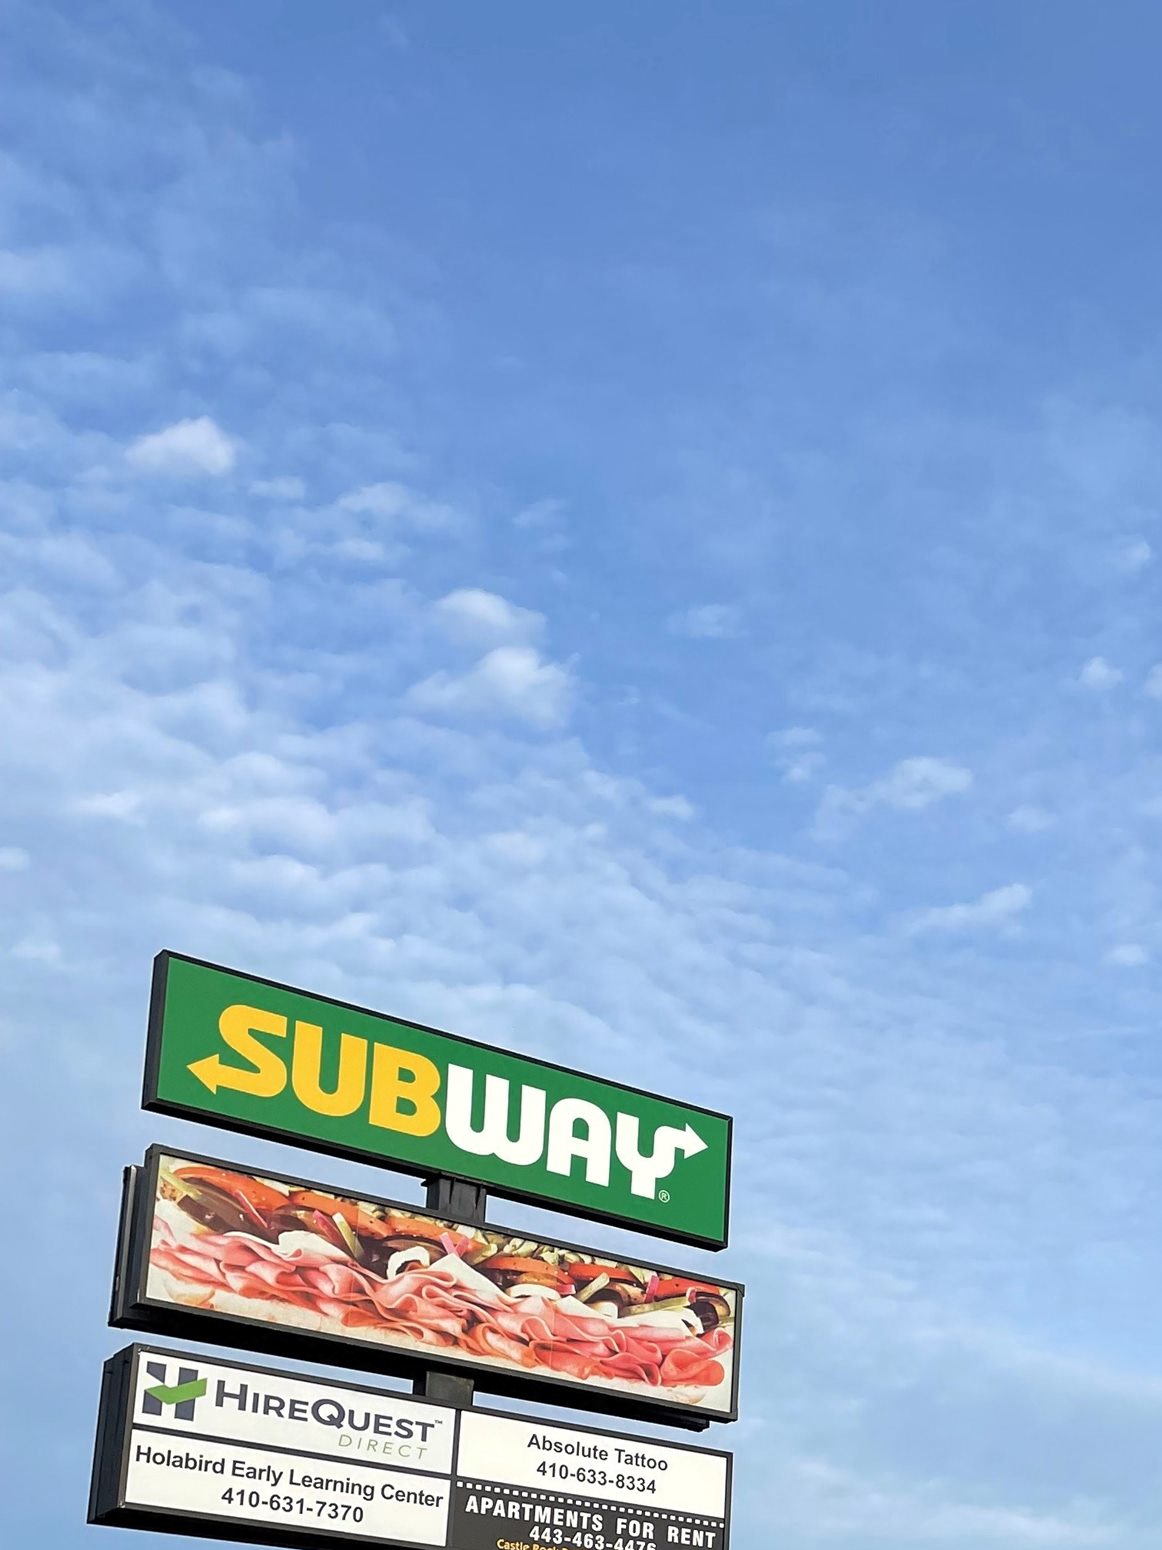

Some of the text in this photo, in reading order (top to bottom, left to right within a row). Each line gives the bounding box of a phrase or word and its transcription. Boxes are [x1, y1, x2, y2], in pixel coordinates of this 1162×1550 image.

[187, 1004, 708, 1200] SUBWAY
[215, 1380, 435, 1443] HIREQUEST
[338, 1434, 428, 1461] DIRECT
[527, 1433, 668, 1471] Absolute Tattoo
[135, 1445, 444, 1508] Holabird Early Learning Center
[536, 1461, 656, 1494] 410-633-8334
[221, 1487, 364, 1523] 410-631-7370
[465, 1495, 716, 1548] APARTMENTS FOR RENT
